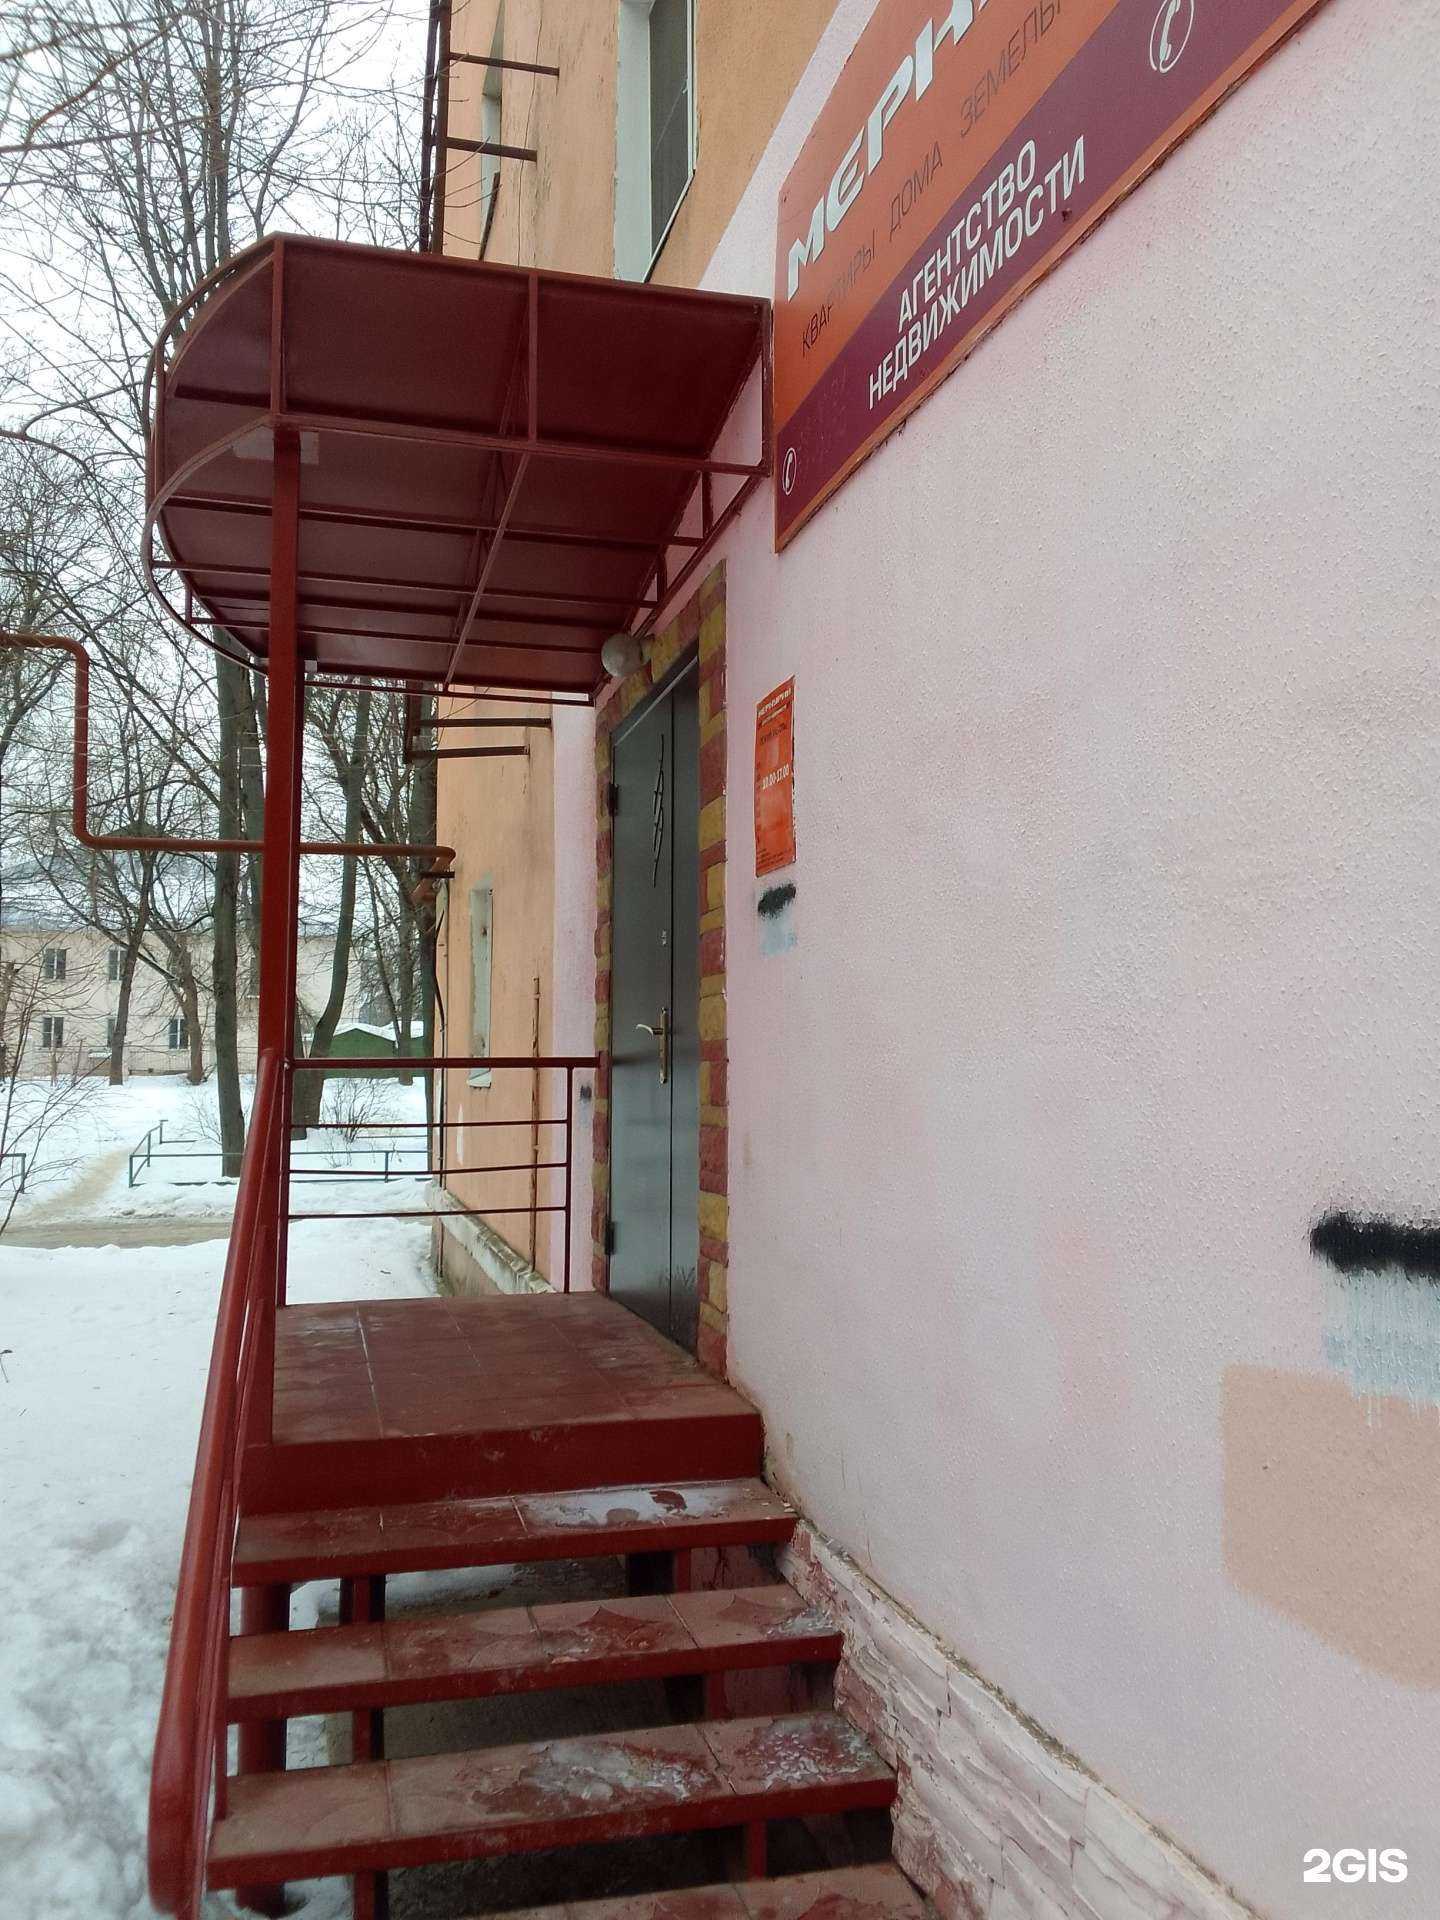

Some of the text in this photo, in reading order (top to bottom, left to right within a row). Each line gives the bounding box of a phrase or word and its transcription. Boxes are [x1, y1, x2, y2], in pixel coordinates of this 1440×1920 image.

[869, 134, 1085, 411] НЕДВИЖИМОСТИ
[888, 140, 943, 242] ДОМА
[898, 139, 1036, 333] АГЕНТСТВО
